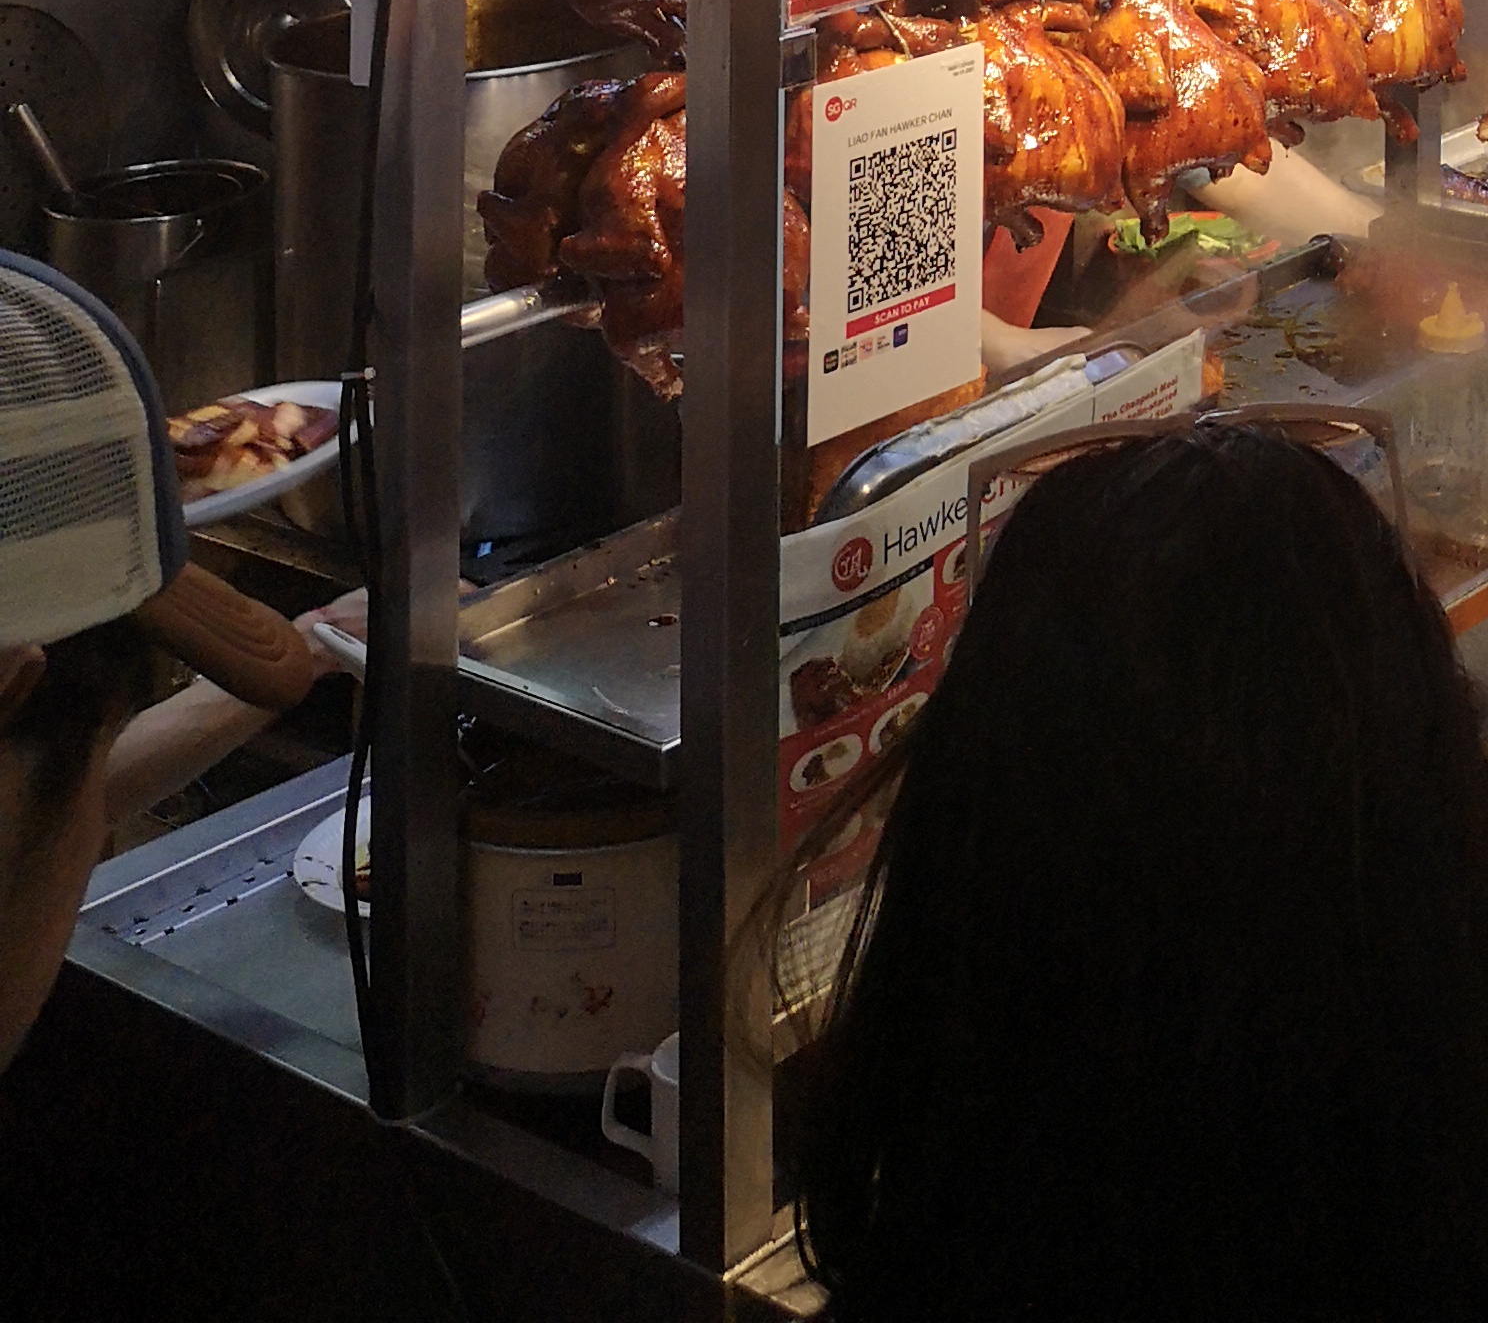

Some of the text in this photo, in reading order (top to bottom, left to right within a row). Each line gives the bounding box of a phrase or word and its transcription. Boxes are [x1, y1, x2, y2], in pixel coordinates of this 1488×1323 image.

[848, 108, 953, 147] LIAO FAN HAWKER CHAN
[874, 296, 930, 325] SCAN TO PAY
